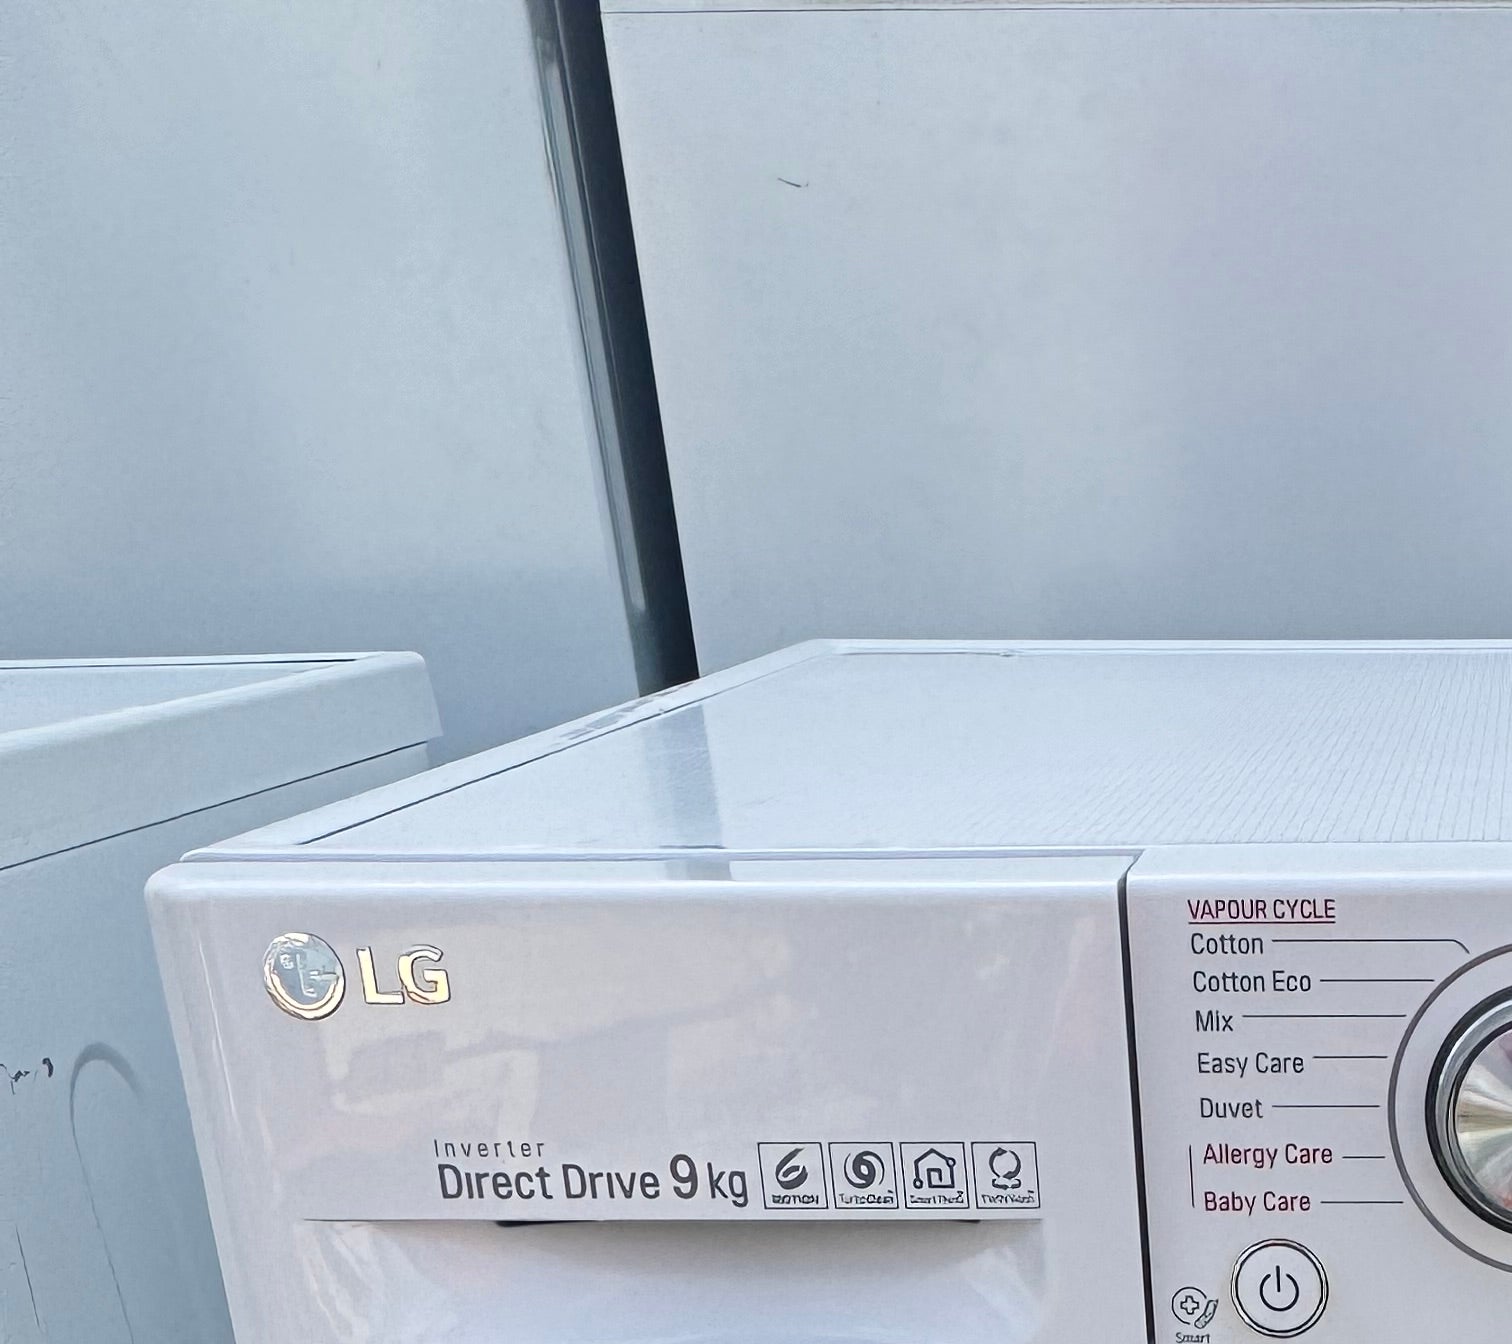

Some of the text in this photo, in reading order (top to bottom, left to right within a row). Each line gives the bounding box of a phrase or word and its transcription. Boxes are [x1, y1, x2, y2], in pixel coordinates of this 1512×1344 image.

[1187, 898, 1336, 919] VAPOUR CYCLE
[1191, 933, 1264, 955] Cotton
[357, 944, 451, 1005] LG
[1193, 970, 1312, 993] Cotton Eco
[1195, 1010, 1234, 1033] Mix
[1197, 1052, 1305, 1078] Easy Care
[1200, 1098, 1264, 1119] Duvet
[433, 1137, 546, 1160] Inverter
[1203, 1144, 1333, 1169] Allergy Care
[439, 1163, 552, 1201] Direct
[562, 1161, 661, 1200] Drive
[1204, 1191, 1312, 1216] Baby Care
